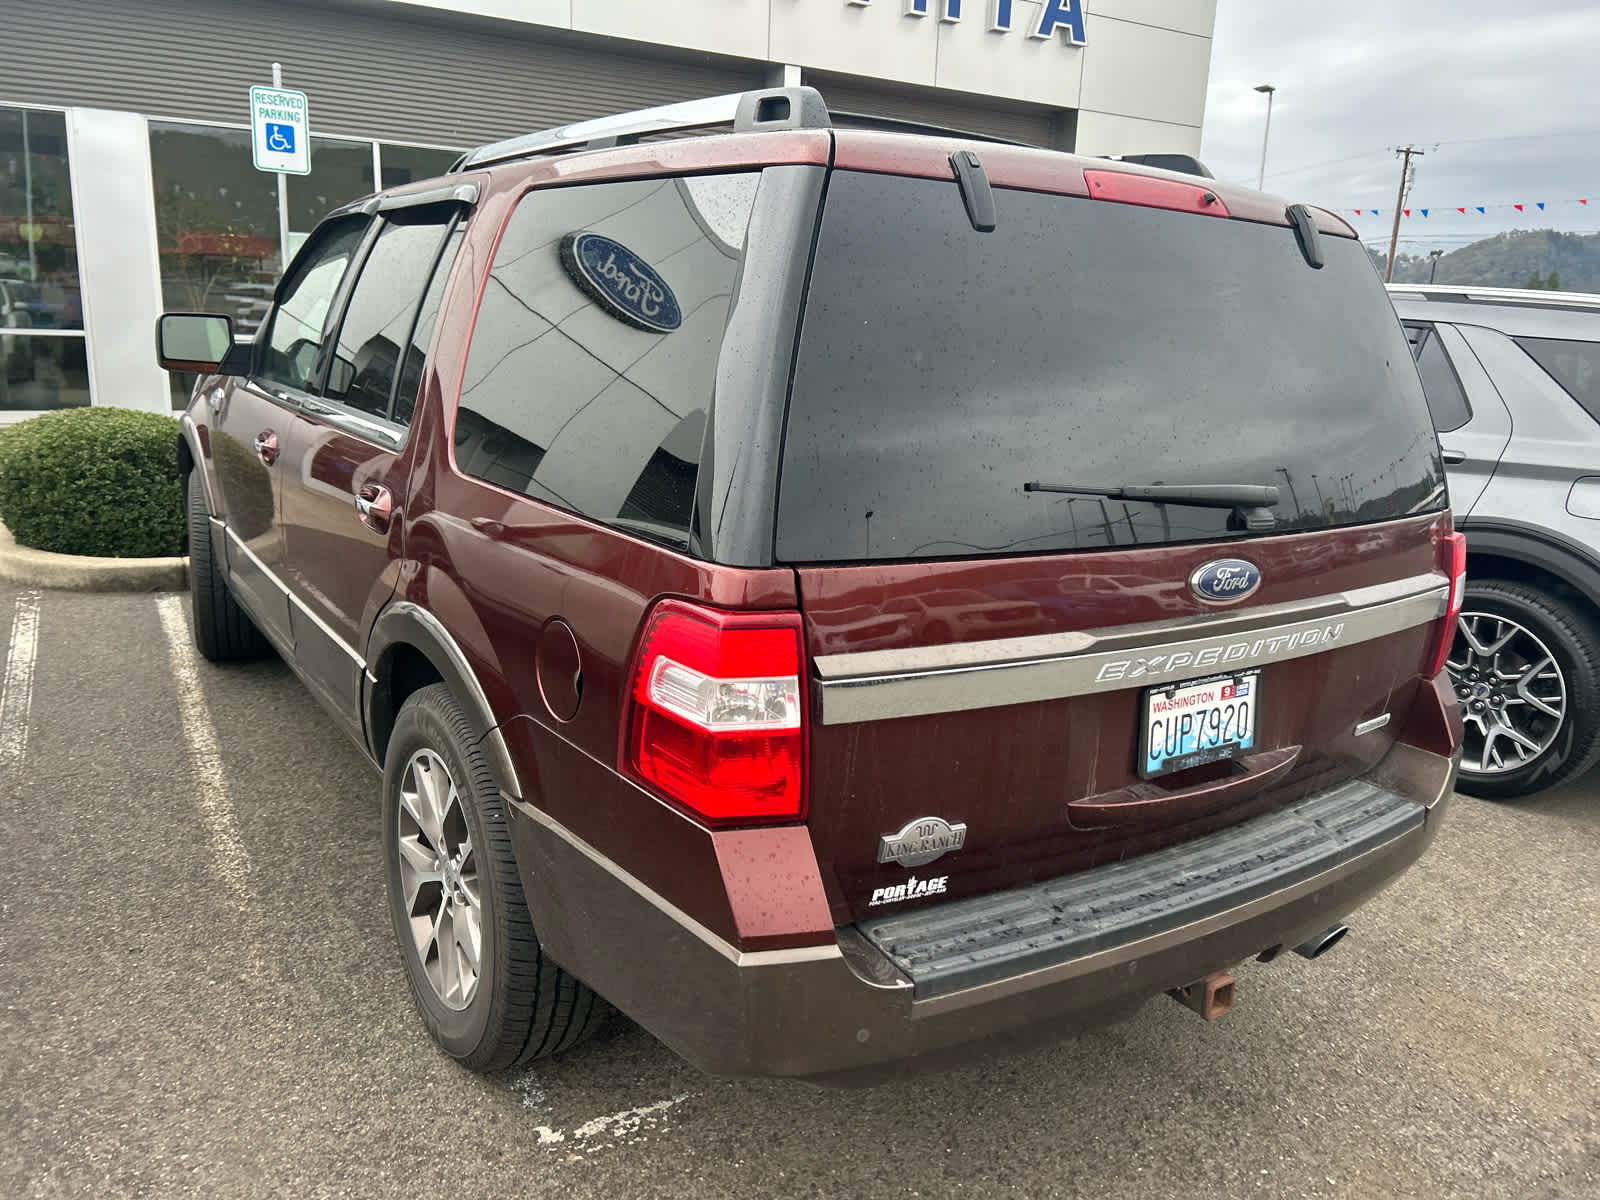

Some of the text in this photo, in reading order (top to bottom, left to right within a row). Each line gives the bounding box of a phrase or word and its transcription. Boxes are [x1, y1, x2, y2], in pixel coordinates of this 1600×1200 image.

[255, 92, 303, 109] RESERVED
[258, 107, 301, 123] PARKING
[1213, 567, 1250, 592] Ford
[1095, 623, 1344, 683] EXPEDITION
[1152, 691, 1215, 713] WASHINGTON
[1149, 701, 1249, 761] CUP7920
[886, 831, 963, 858] KING RANCH
